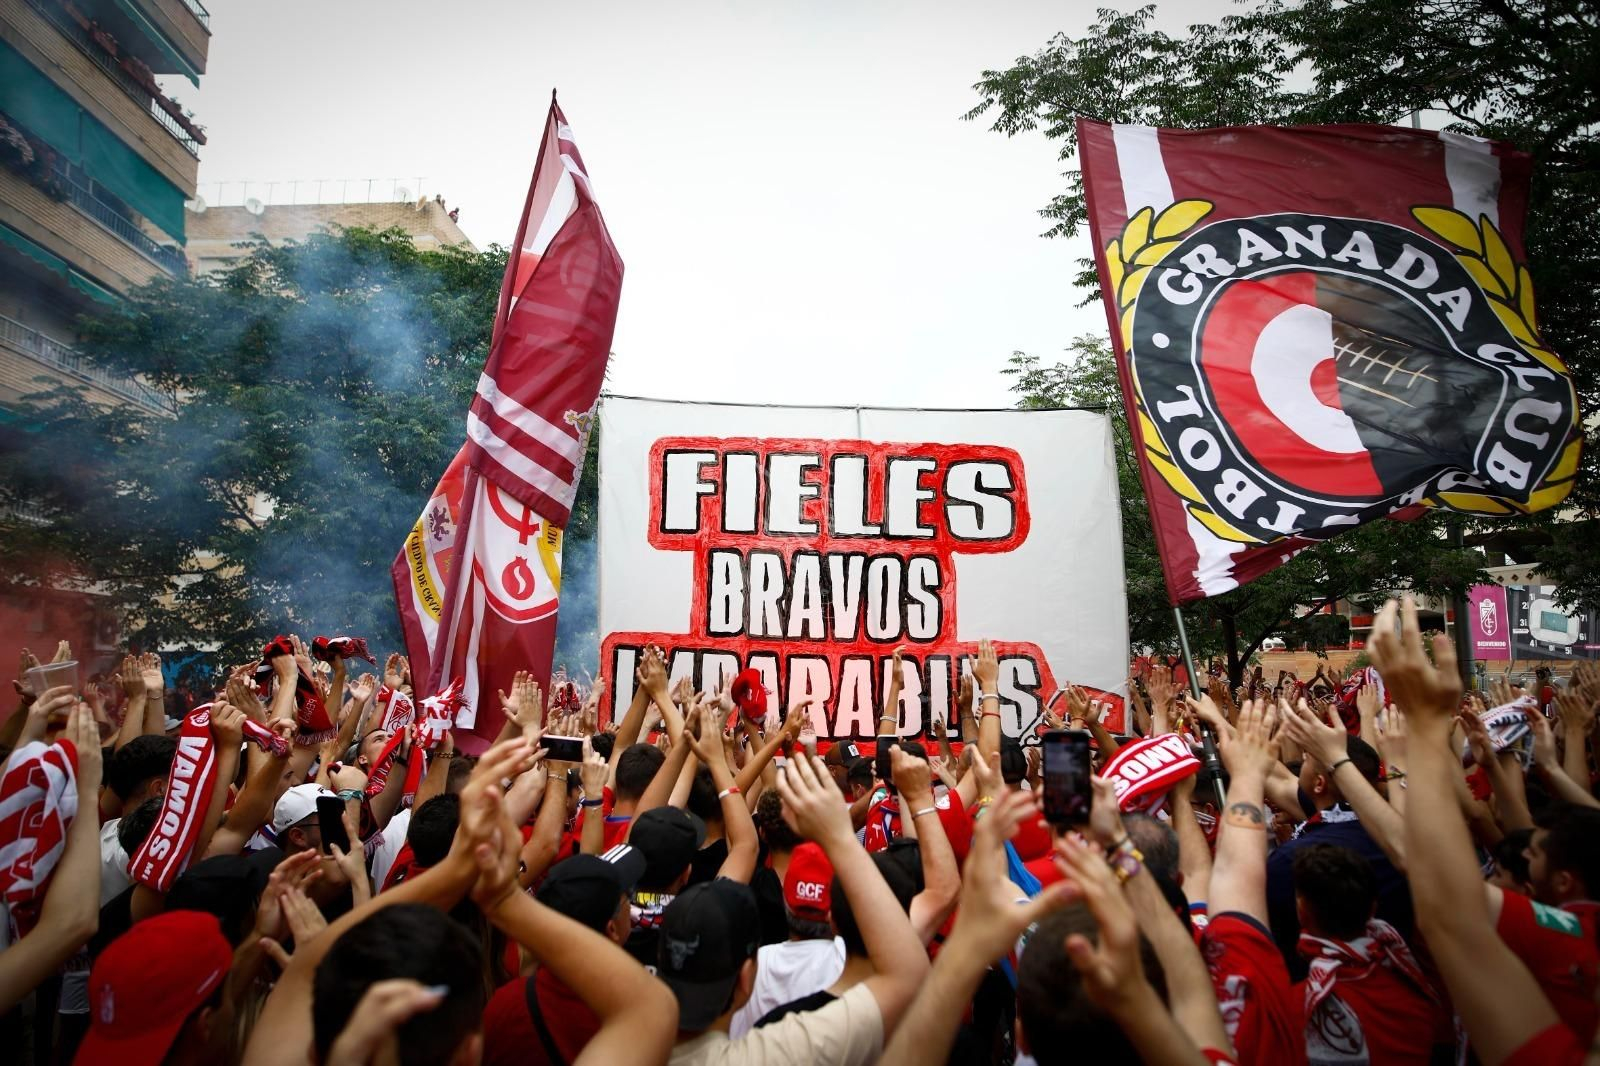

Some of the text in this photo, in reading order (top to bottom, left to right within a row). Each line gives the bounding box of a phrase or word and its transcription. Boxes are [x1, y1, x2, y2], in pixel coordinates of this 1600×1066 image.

[1158, 224, 1472, 332] GRANADA
[1157, 384, 1361, 534] TBOL
[1477, 343, 1564, 491] CLUB
[660, 449, 1016, 541] FIELES
[707, 548, 941, 643] BRAVOS
[149, 736, 209, 861] VAMOS
[1111, 735, 1190, 797] AMOS
[796, 880, 825, 899] GCF
